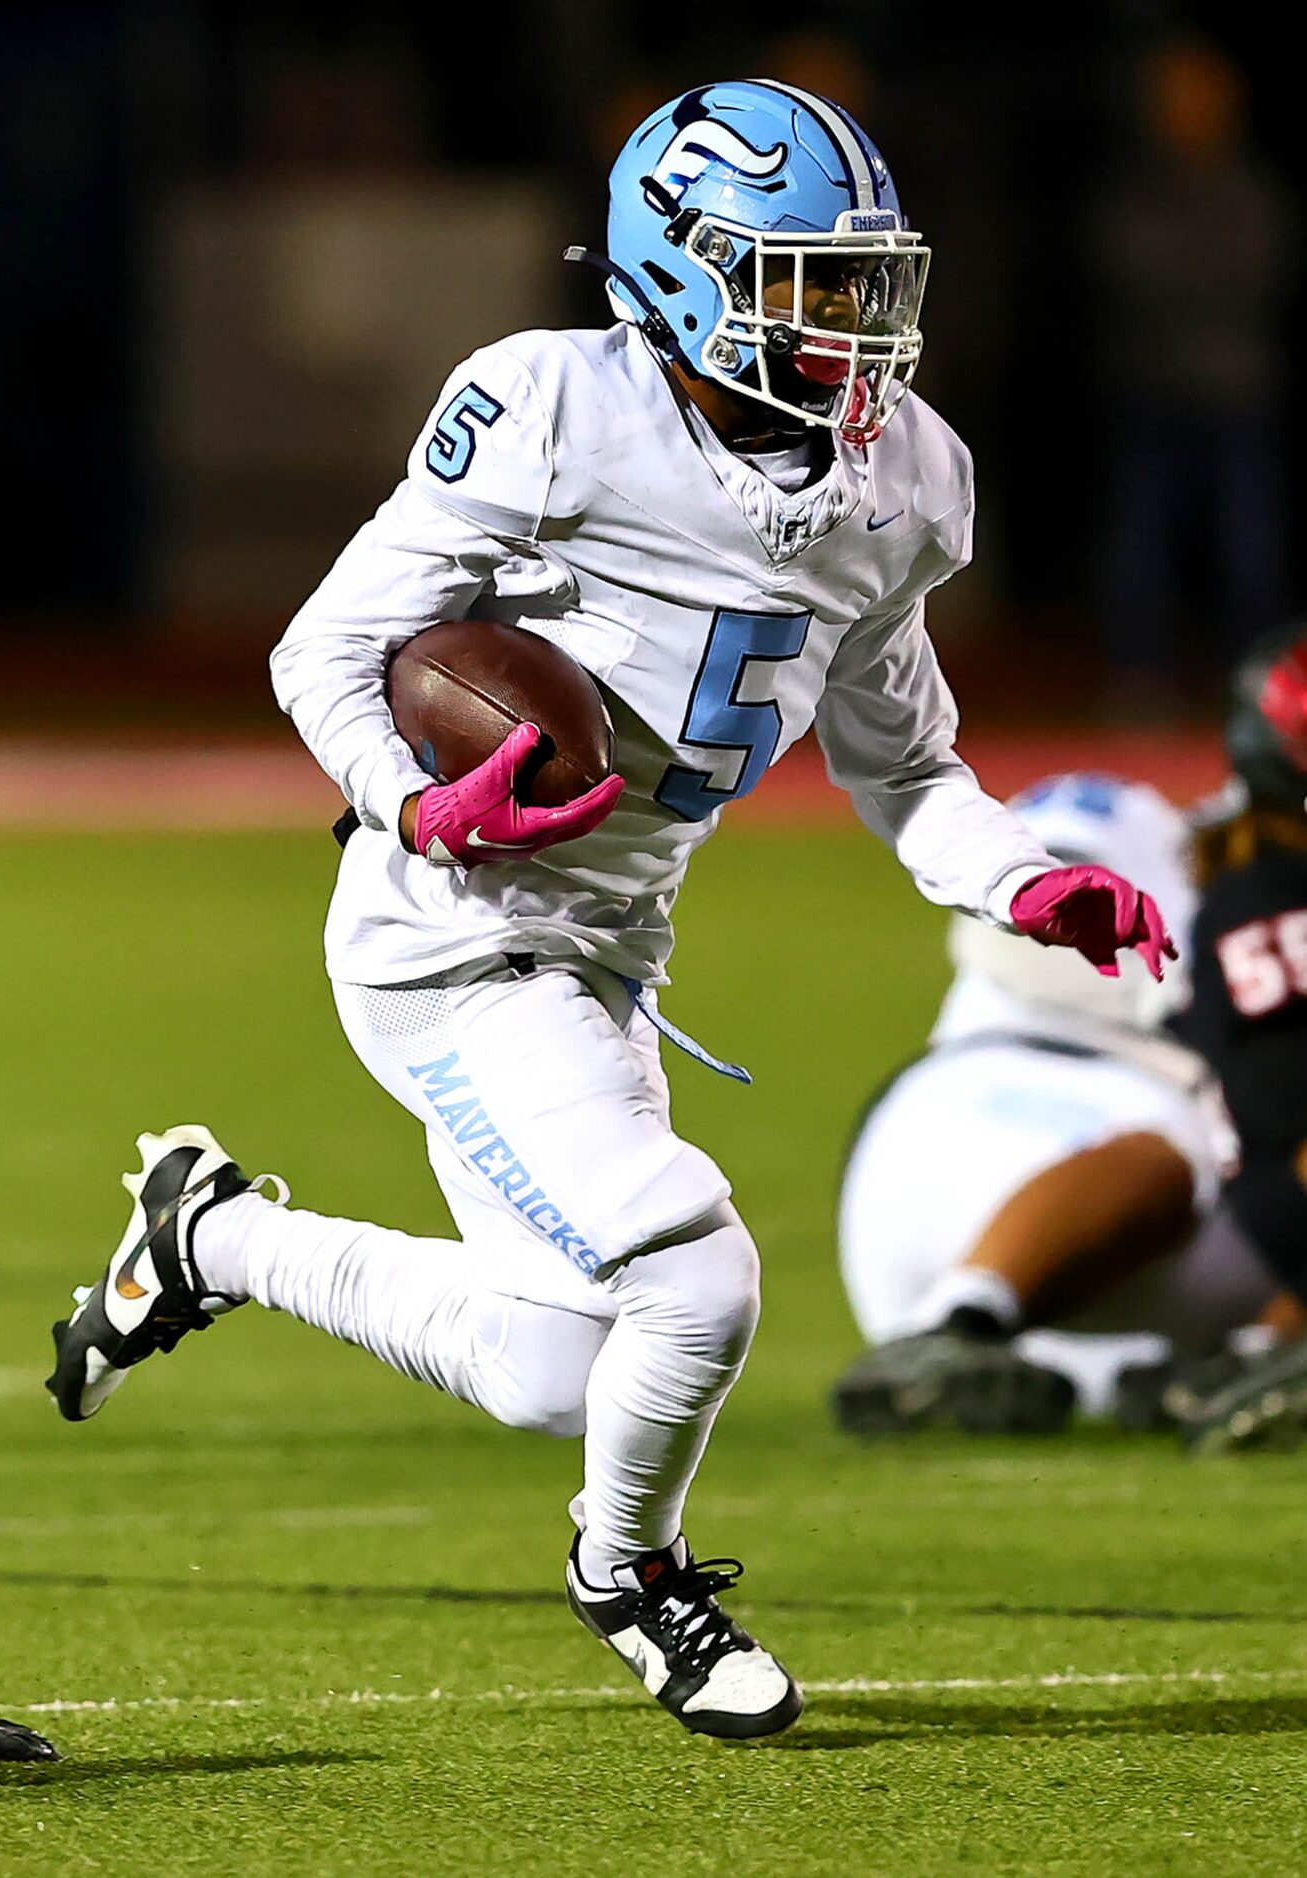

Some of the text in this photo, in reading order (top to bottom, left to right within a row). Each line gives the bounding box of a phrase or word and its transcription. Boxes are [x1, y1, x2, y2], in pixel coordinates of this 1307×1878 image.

[426, 381, 505, 484] 5
[653, 606, 815, 823] 5
[406, 1049, 603, 1275] MAVERICKS
